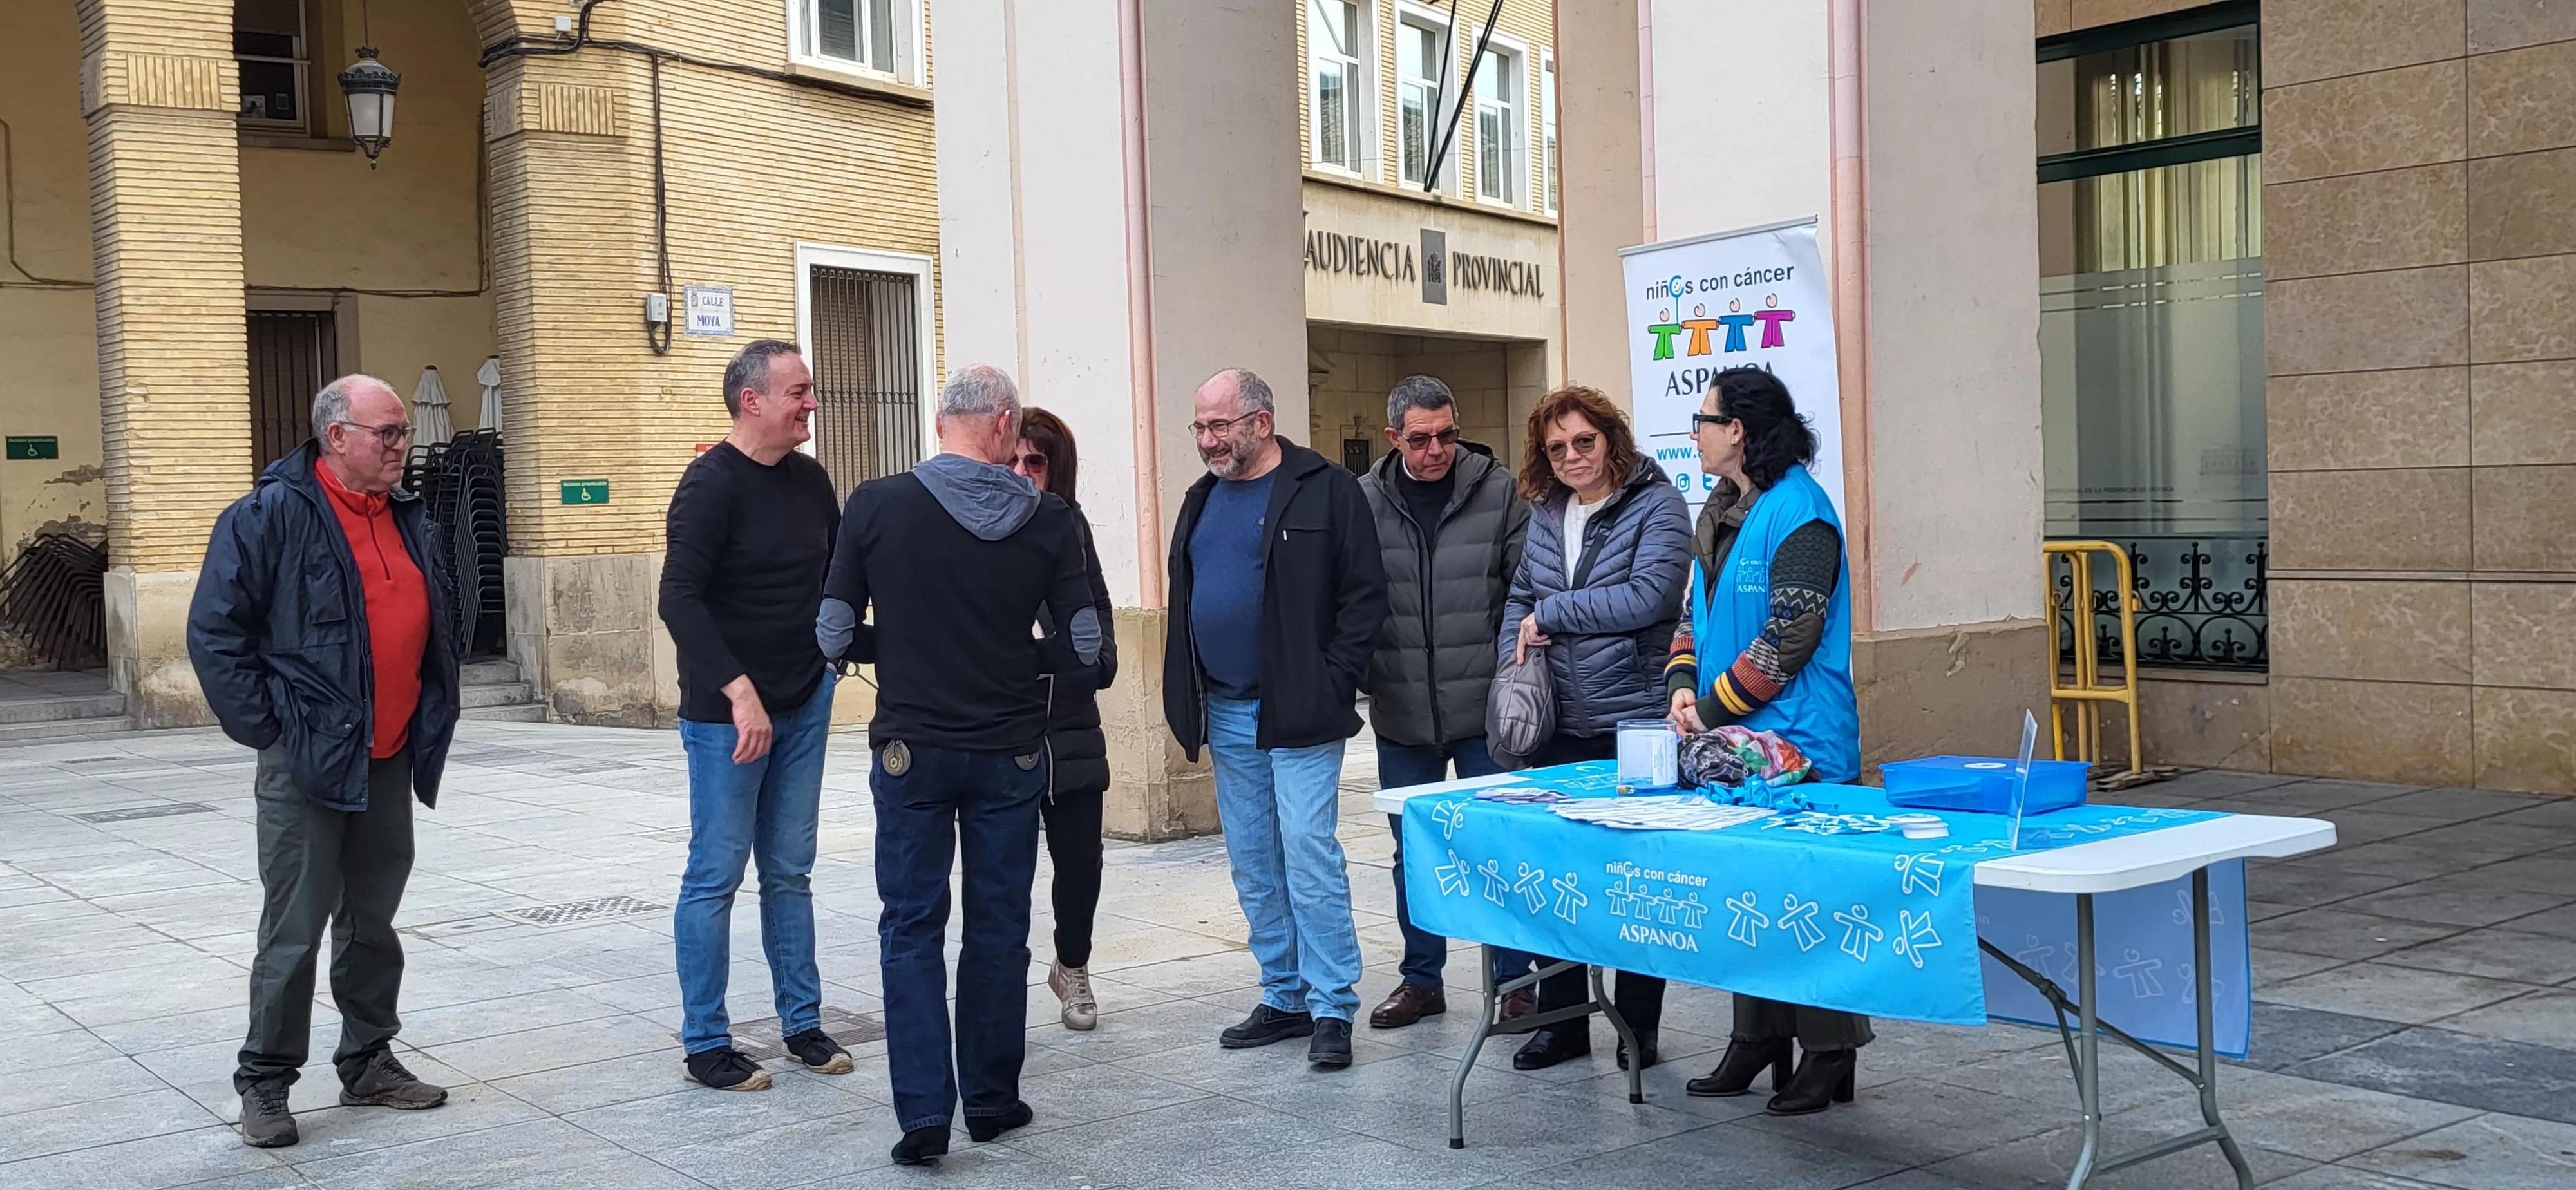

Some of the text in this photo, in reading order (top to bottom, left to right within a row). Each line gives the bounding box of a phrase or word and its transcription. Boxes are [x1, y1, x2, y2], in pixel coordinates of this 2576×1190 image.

[1305, 229, 1544, 298] AUDIENCIA PROVINCIAL
[1700, 276, 1728, 292] con
[1734, 266, 1794, 287] cáncer
[702, 296, 724, 307] CALLE
[697, 315, 721, 327] MOYA
[1665, 361, 1774, 397] ASPA
[1643, 868, 1664, 880] con
[1667, 870, 1708, 887] cáncer
[1618, 923, 1700, 953] ASPANOA
